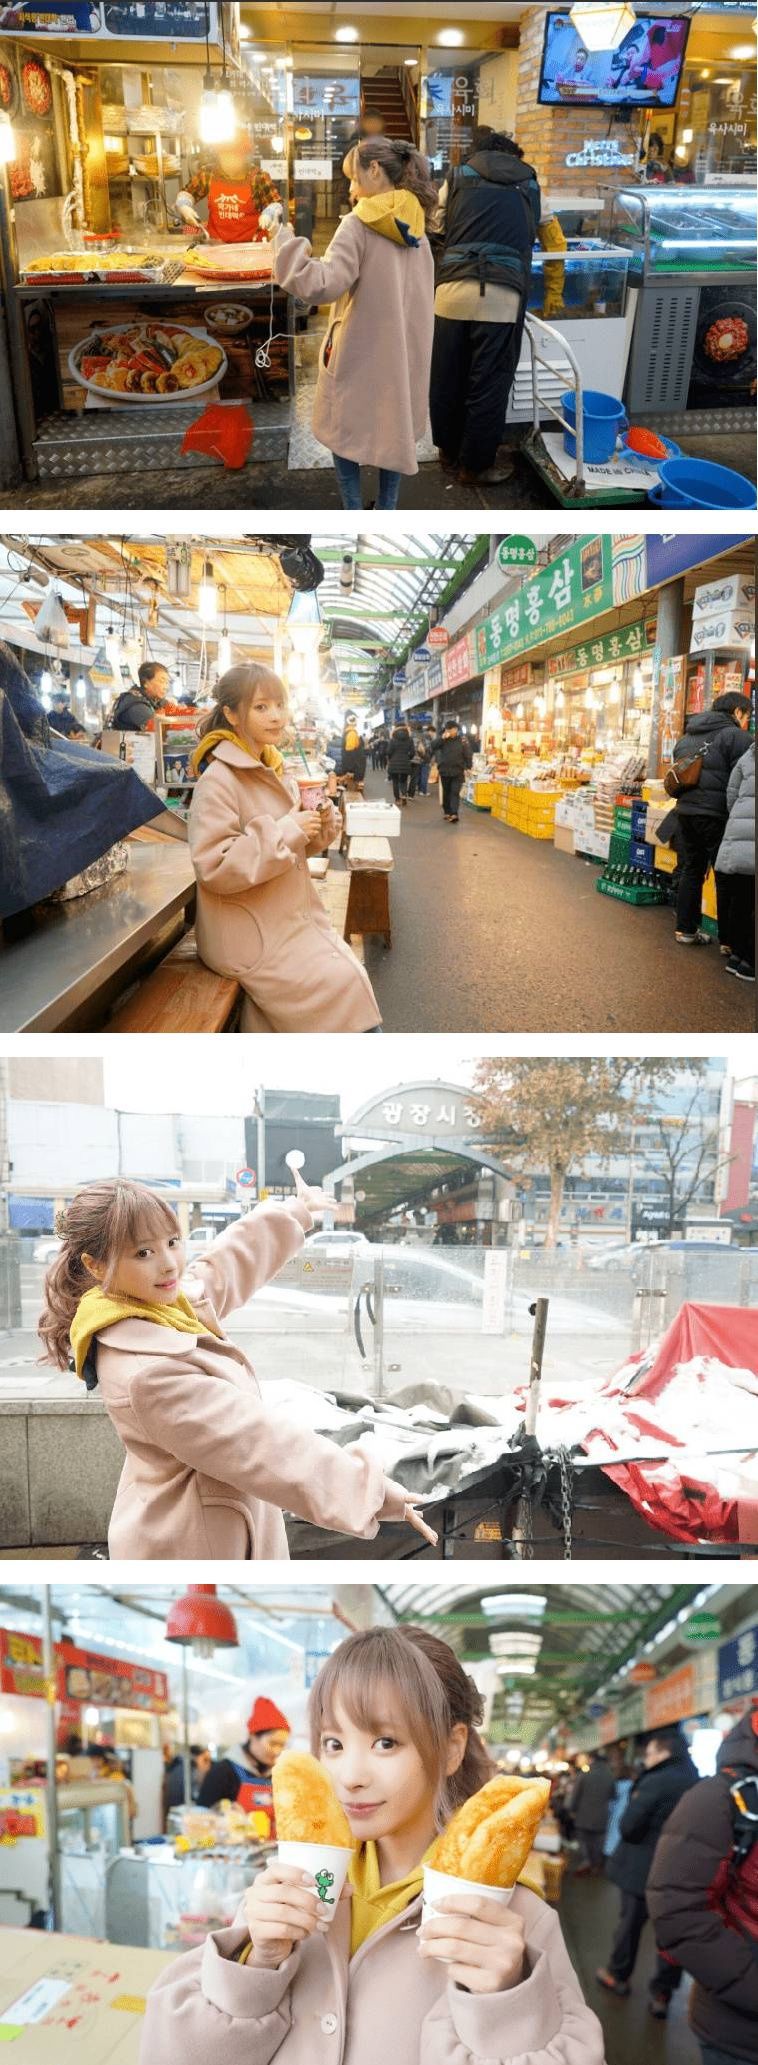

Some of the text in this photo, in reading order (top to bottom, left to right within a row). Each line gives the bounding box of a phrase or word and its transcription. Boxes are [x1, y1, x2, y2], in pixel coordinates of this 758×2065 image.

[587, 466, 612, 475] MADE
[501, 546, 535, 561] 동명홍삼
[489, 558, 575, 649] 동명홍삼
[576, 626, 642, 667] 동명홍삼
[381, 1102, 482, 1128] 광장시장
